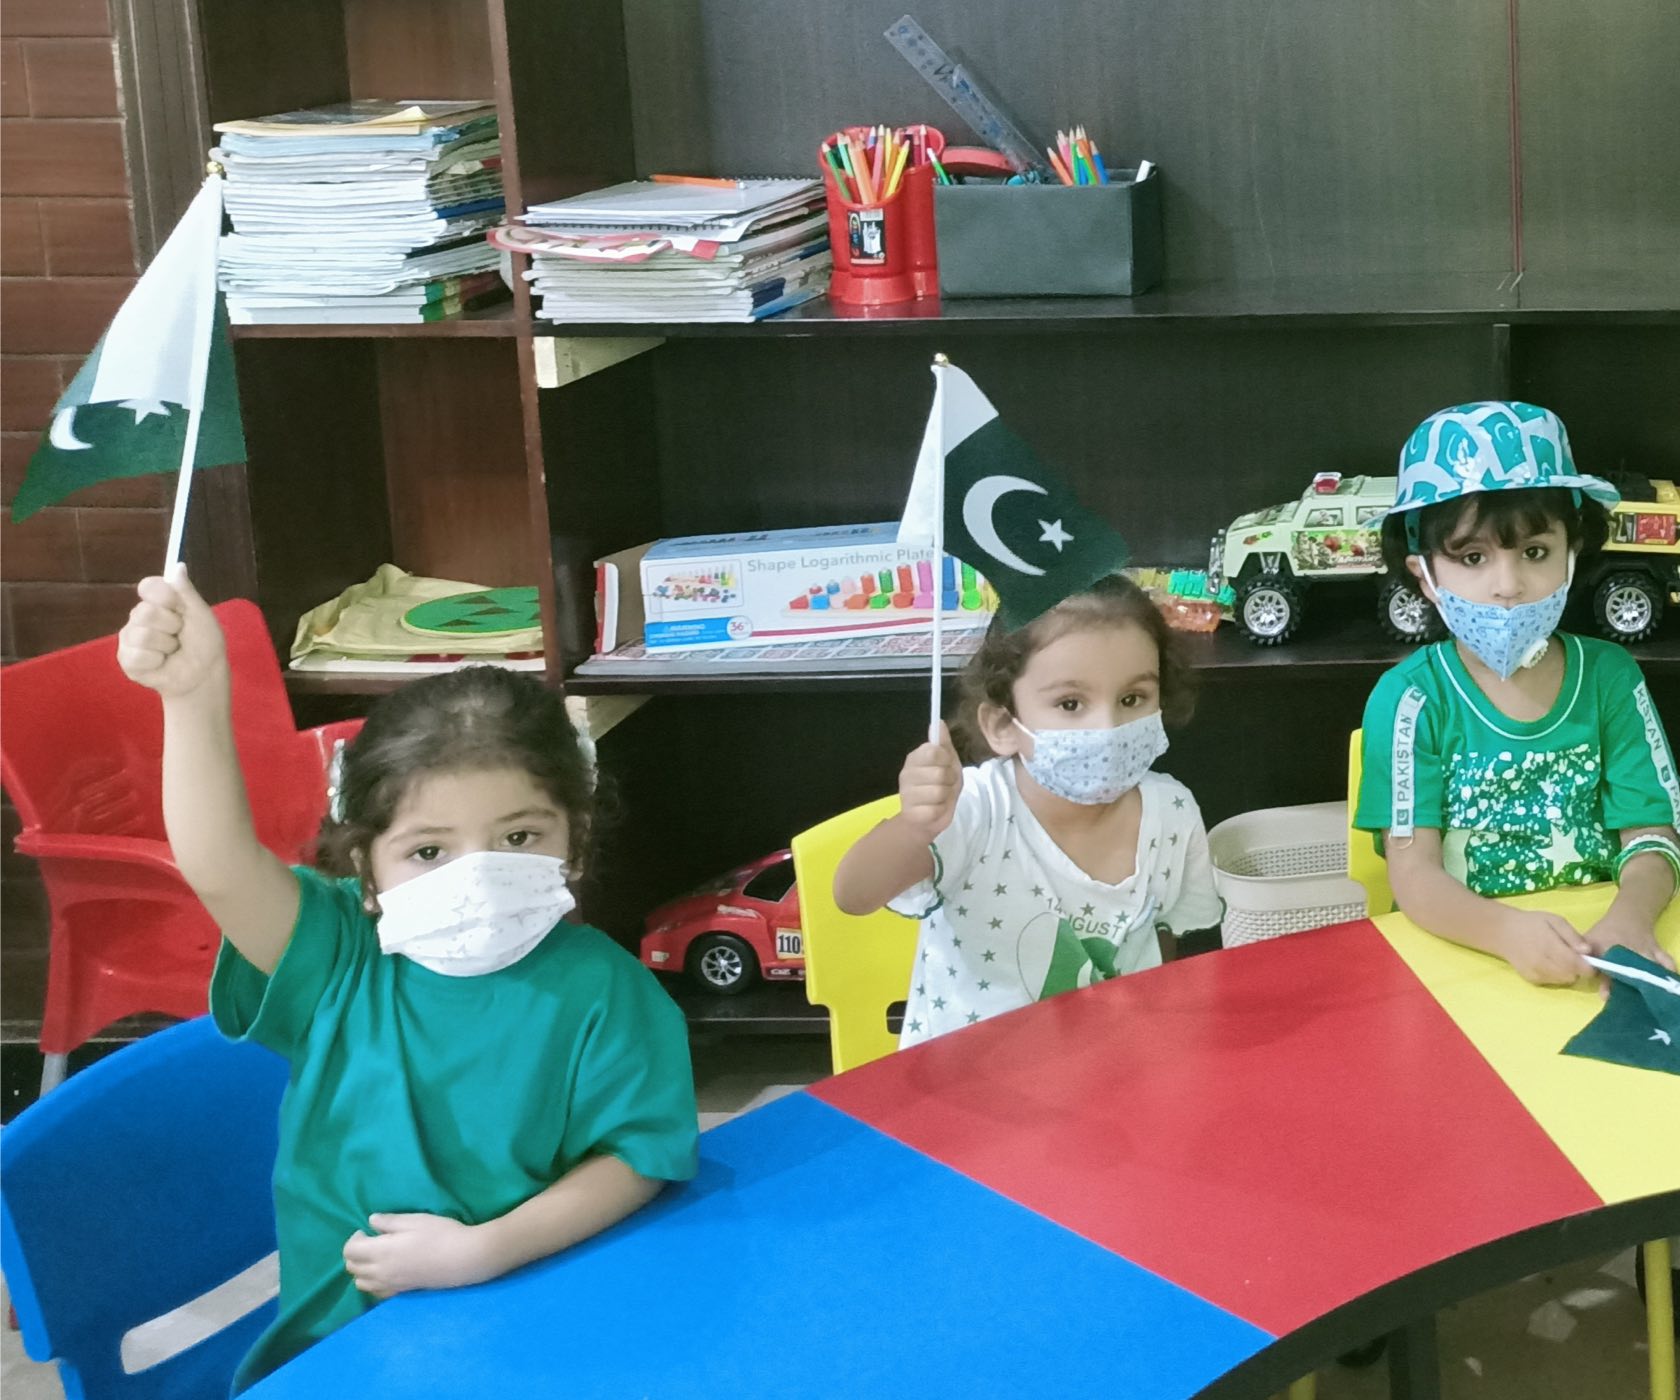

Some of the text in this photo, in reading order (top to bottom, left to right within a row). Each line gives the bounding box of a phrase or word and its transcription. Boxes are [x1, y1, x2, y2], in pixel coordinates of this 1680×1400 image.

[747, 558, 797, 573] Shape
[801, 551, 892, 570] Logarithmic
[1397, 713, 1413, 802] PAKISTAN
[1047, 897, 1063, 915] 14
[778, 934, 801, 955] 110
